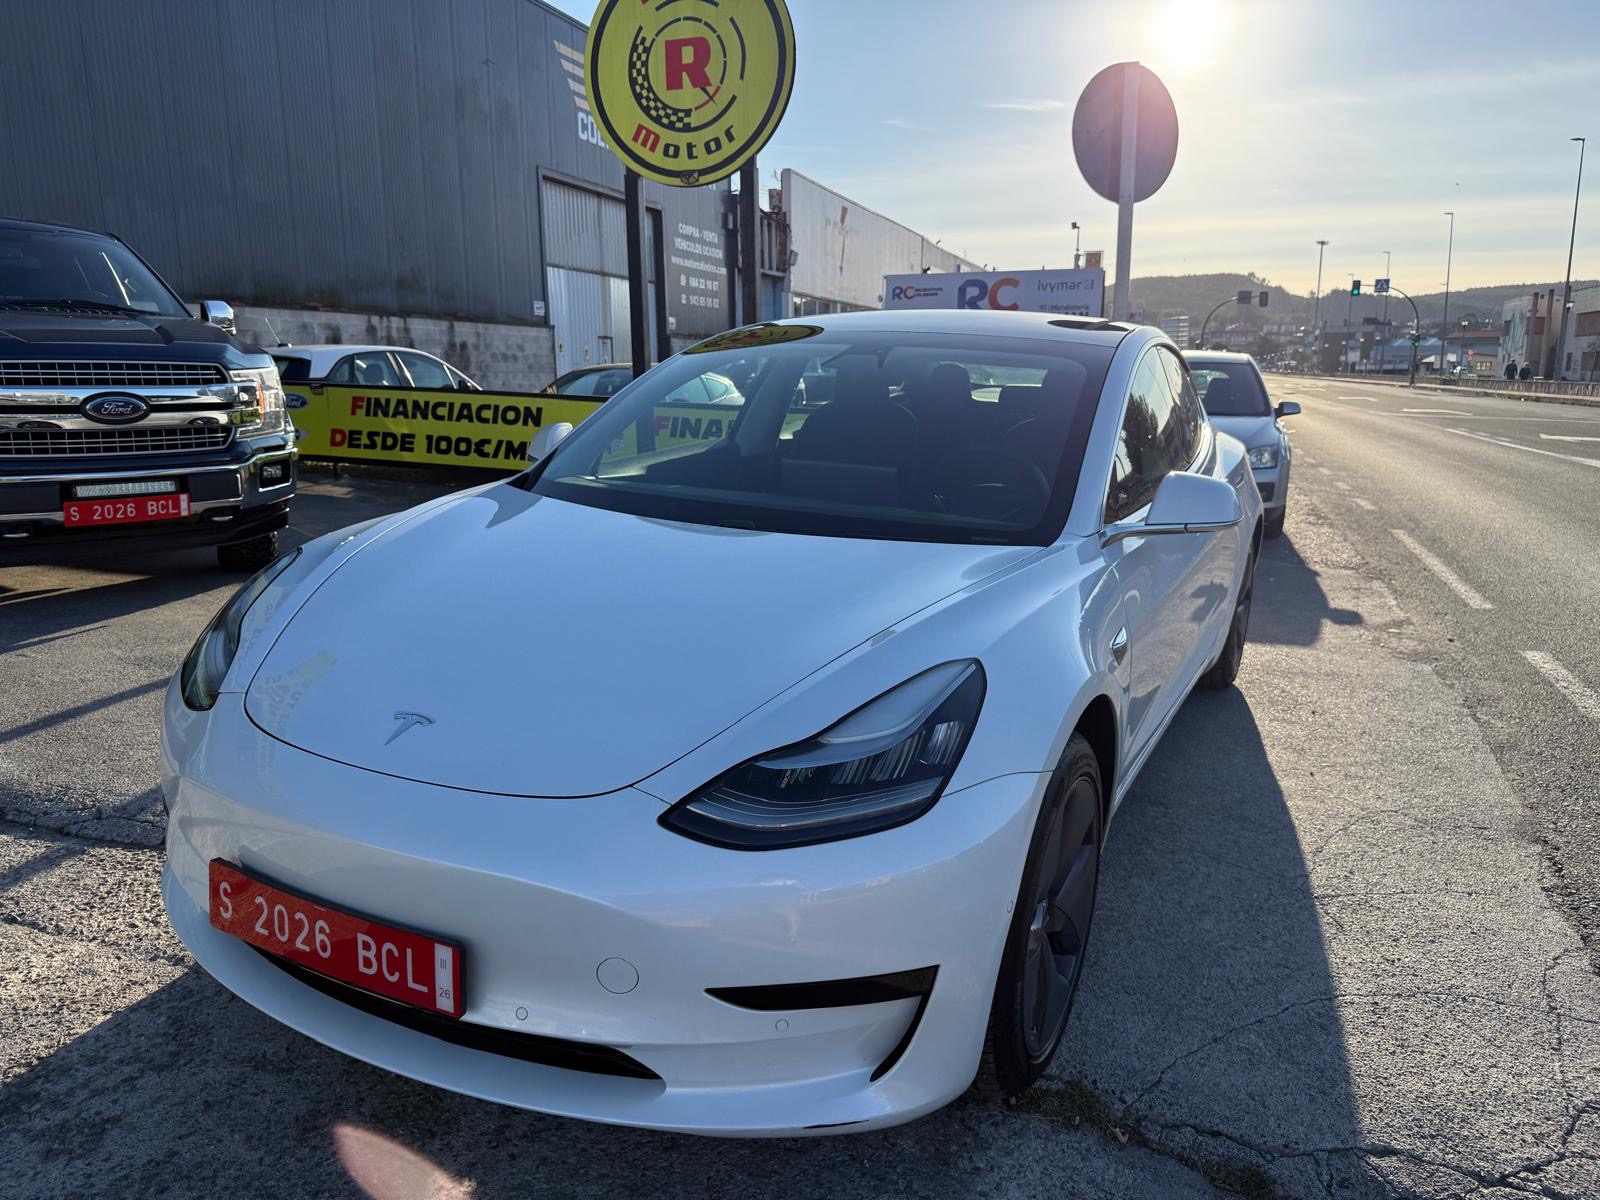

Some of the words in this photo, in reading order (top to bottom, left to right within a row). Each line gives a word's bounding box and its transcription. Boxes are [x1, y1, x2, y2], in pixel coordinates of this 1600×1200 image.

[664, 36, 713, 91] R
[578, 111, 609, 149] COL
[892, 285, 914, 300] RC
[957, 277, 1020, 311] RC
[101, 401, 133, 414] Ford
[351, 395, 543, 427] FINANCIACION
[330, 428, 416, 453] DESDE
[425, 434, 533, 462] 100€/M
[70, 507, 80, 521] S
[92, 503, 137, 520] 2026
[147, 500, 179, 515] BCL
[219, 881, 233, 919] S
[255, 896, 332, 959] 2026
[357, 932, 429, 993] BCL
[439, 987, 451, 1000] 26
